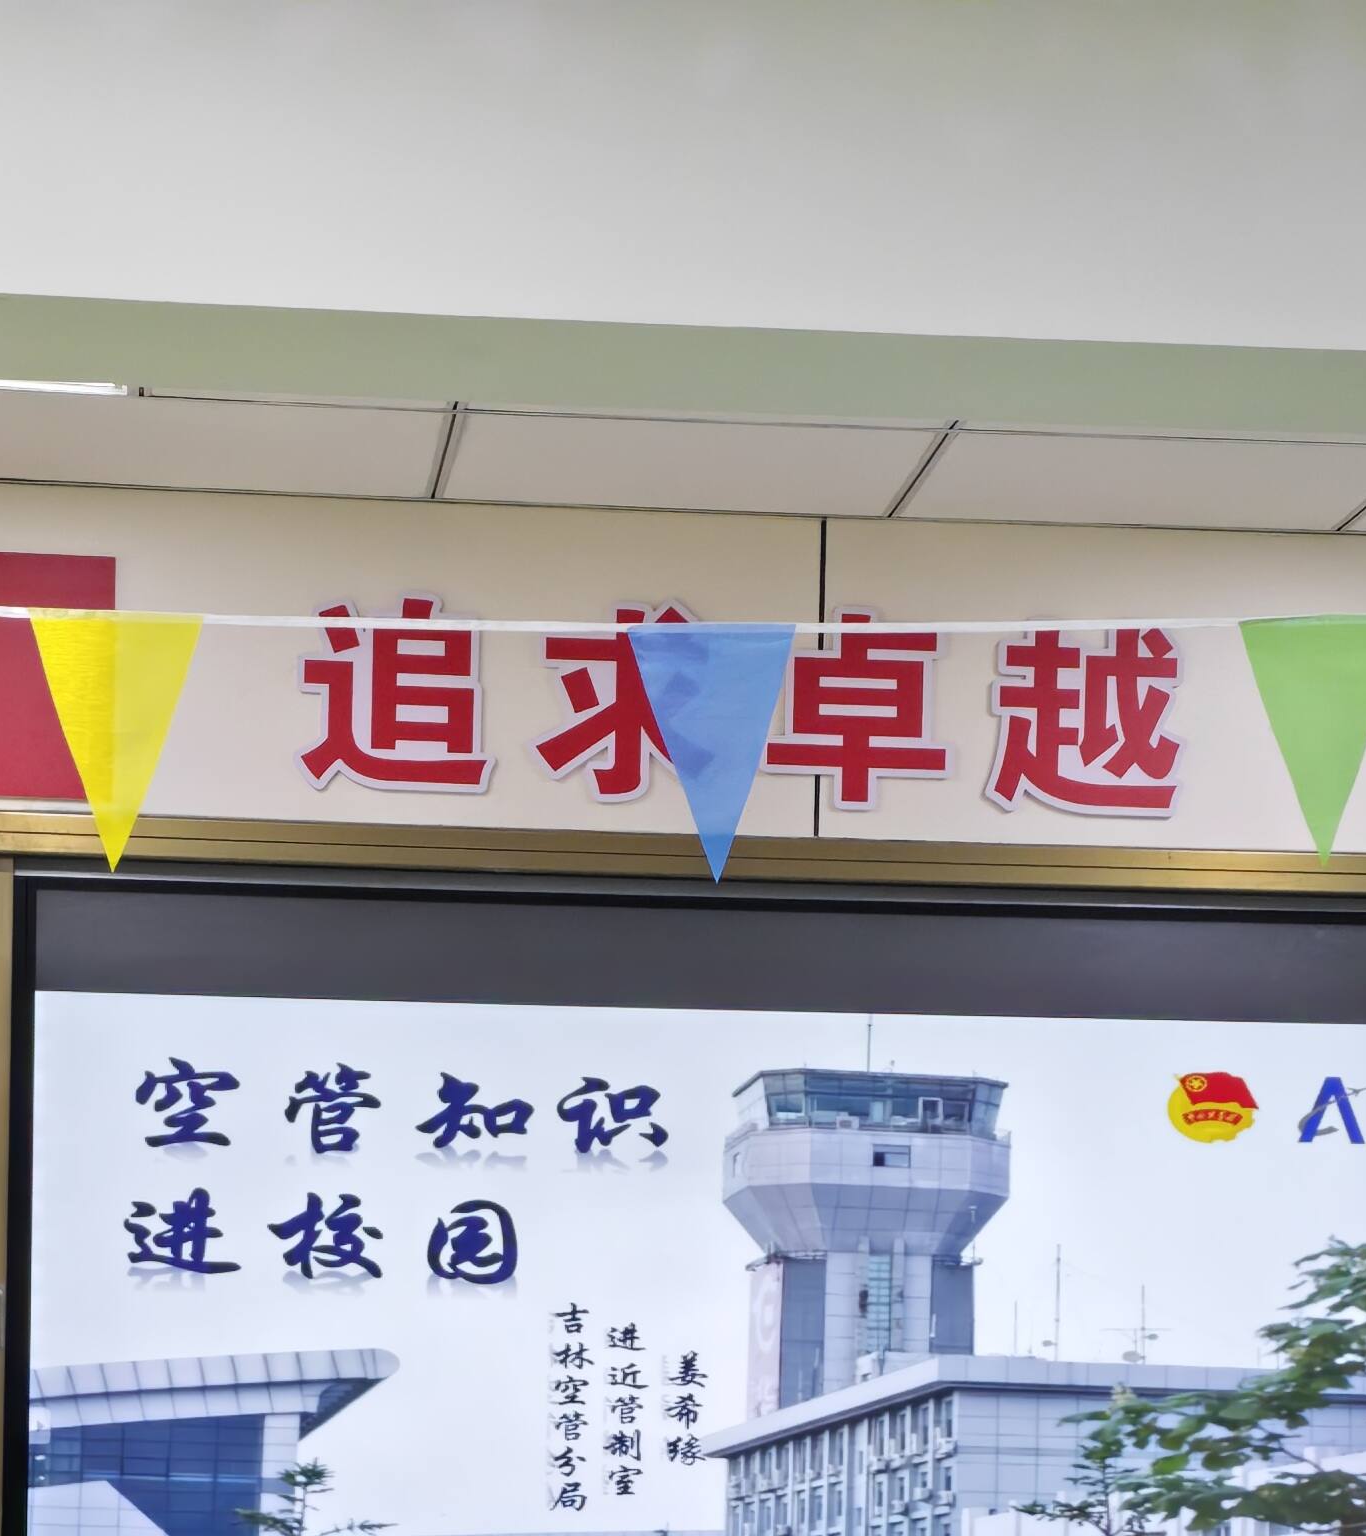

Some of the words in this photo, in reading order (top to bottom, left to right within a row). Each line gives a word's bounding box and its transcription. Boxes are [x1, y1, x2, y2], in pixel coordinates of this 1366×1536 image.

[300, 598, 1178, 810] 追求卓越
[135, 1057, 669, 1154] 空管知识
[124, 1187, 518, 1285] 进校园
[549, 1302, 595, 1512] 吉林空管分局
[602, 1322, 650, 1496] 进近管制室
